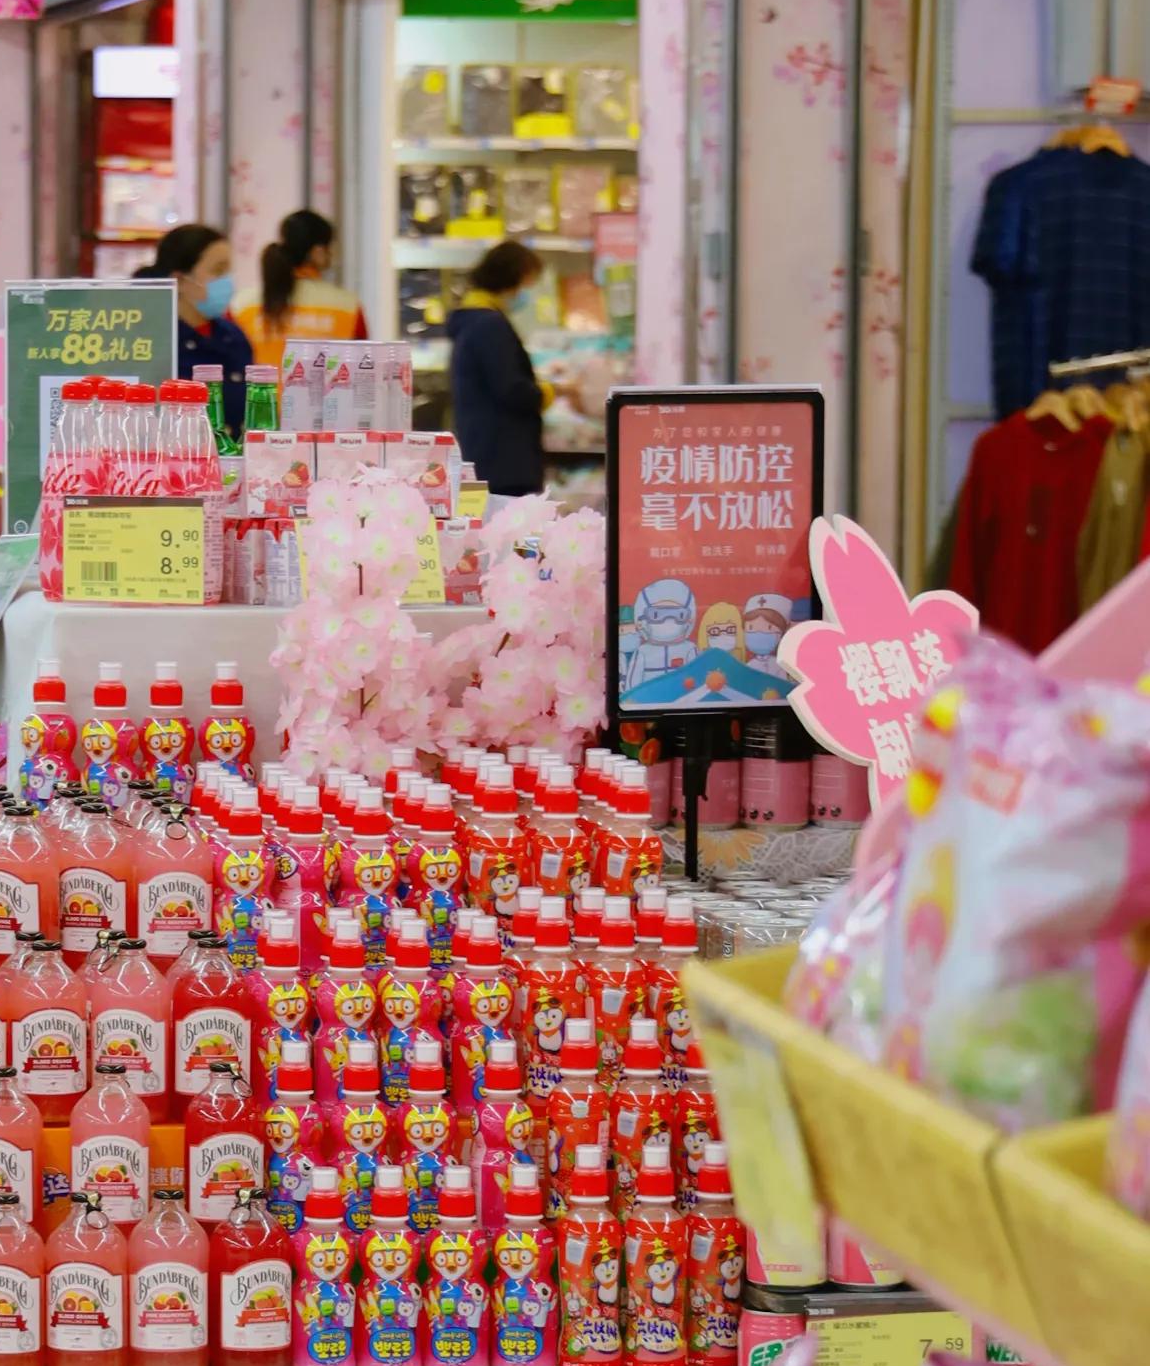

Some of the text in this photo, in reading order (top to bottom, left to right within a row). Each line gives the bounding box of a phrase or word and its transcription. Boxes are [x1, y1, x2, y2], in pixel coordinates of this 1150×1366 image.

[640, 444, 794, 485] 疫情防控
[640, 490, 794, 532] 毫不放松
